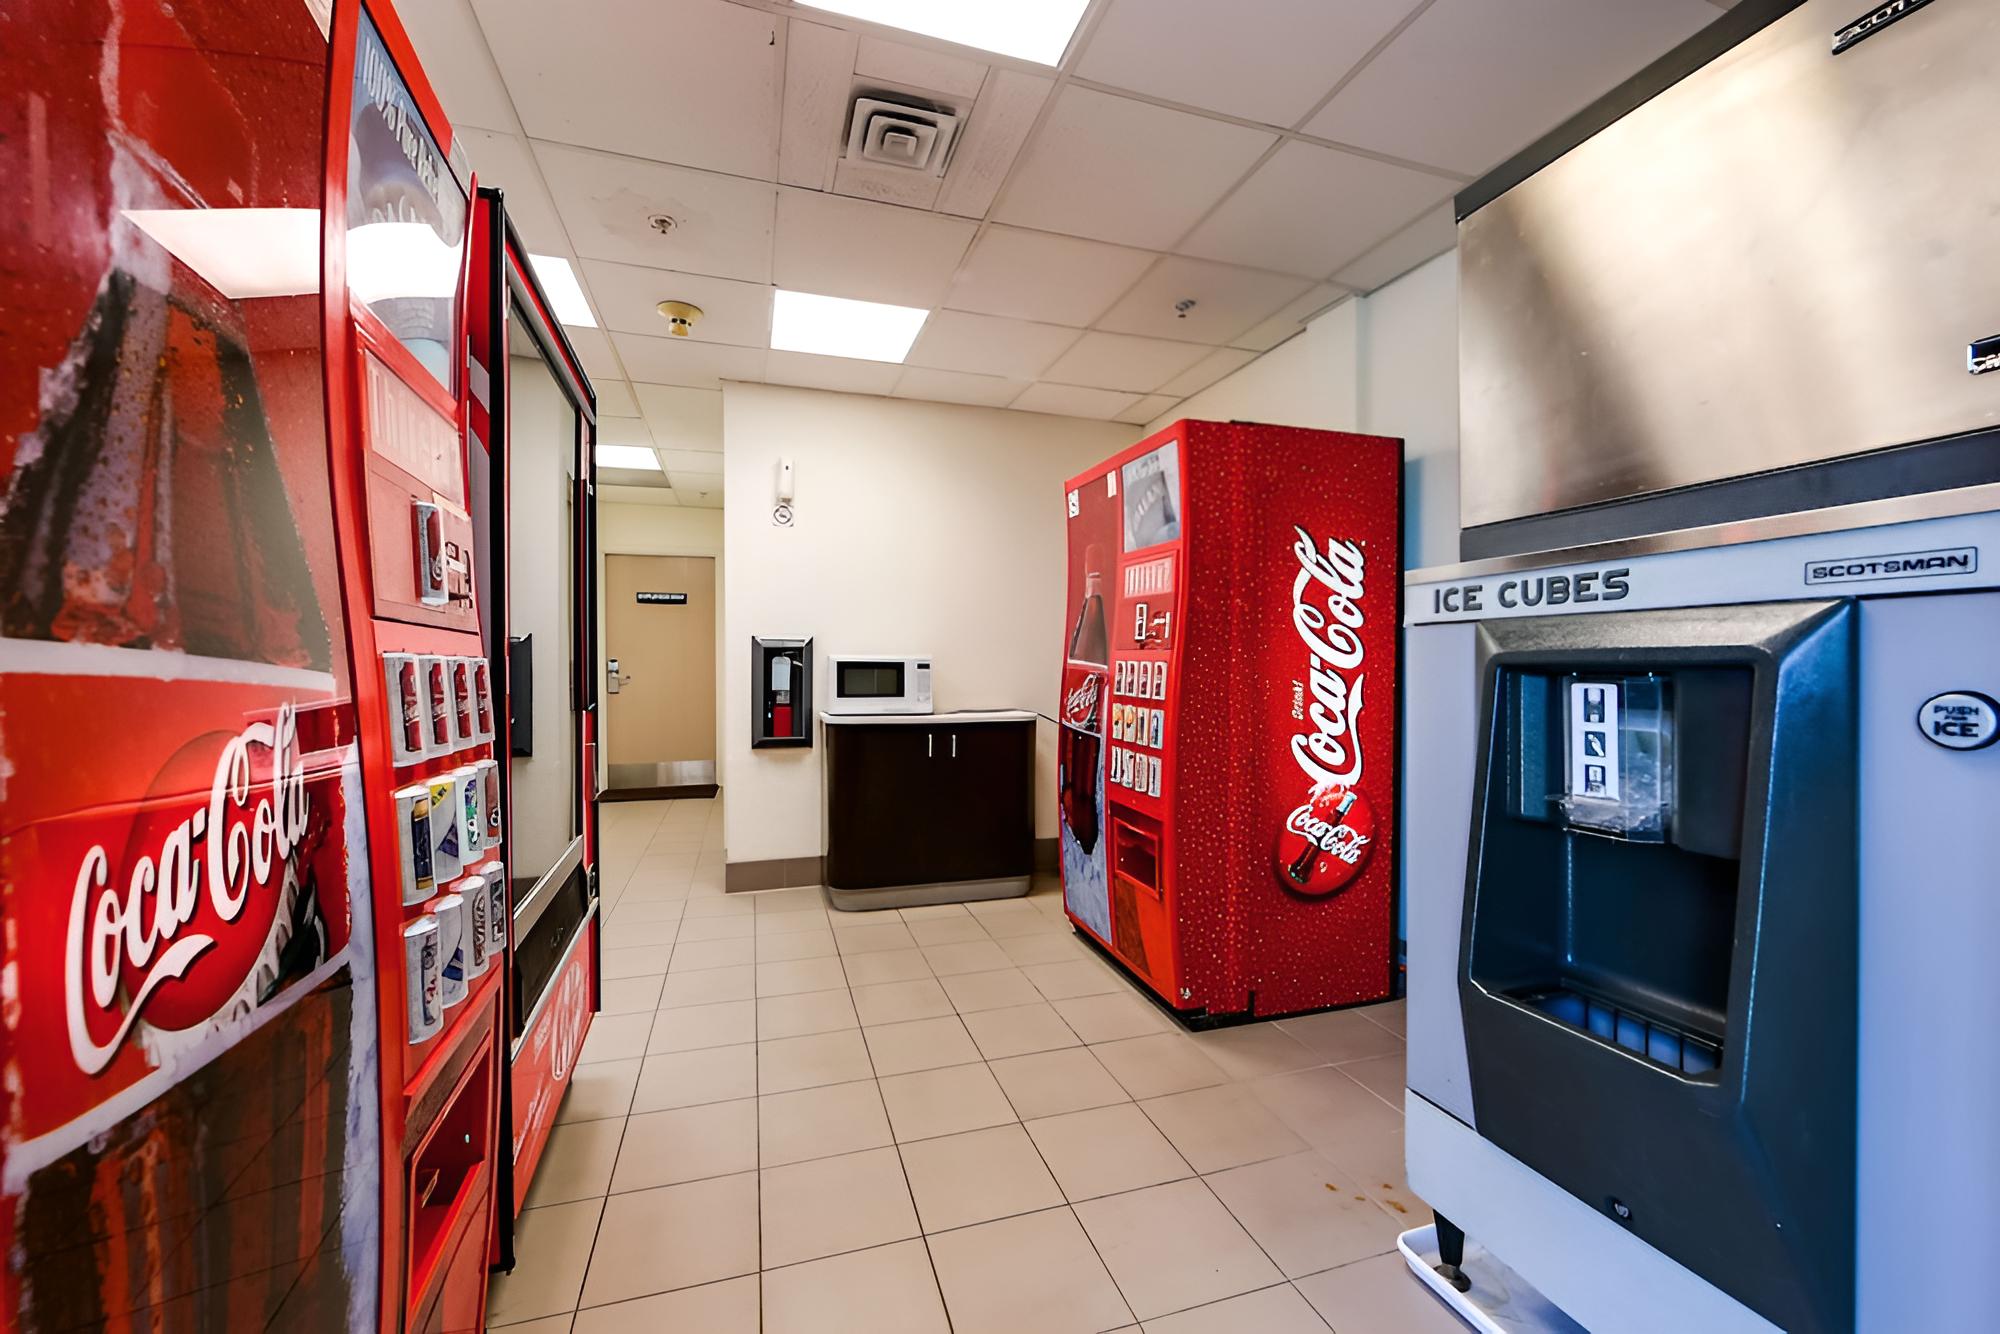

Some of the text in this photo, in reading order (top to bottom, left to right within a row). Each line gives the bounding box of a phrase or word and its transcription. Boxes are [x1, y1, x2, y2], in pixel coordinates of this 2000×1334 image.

[1812, 553, 1970, 580] SCOTSMAN
[1434, 567, 1631, 614] ICE CUBES
[1290, 525, 1365, 787] Coca-Cola
[1933, 704, 1980, 716] PUSH
[1933, 720, 1980, 738] ICE
[65, 701, 310, 1075] Coca-Cola
